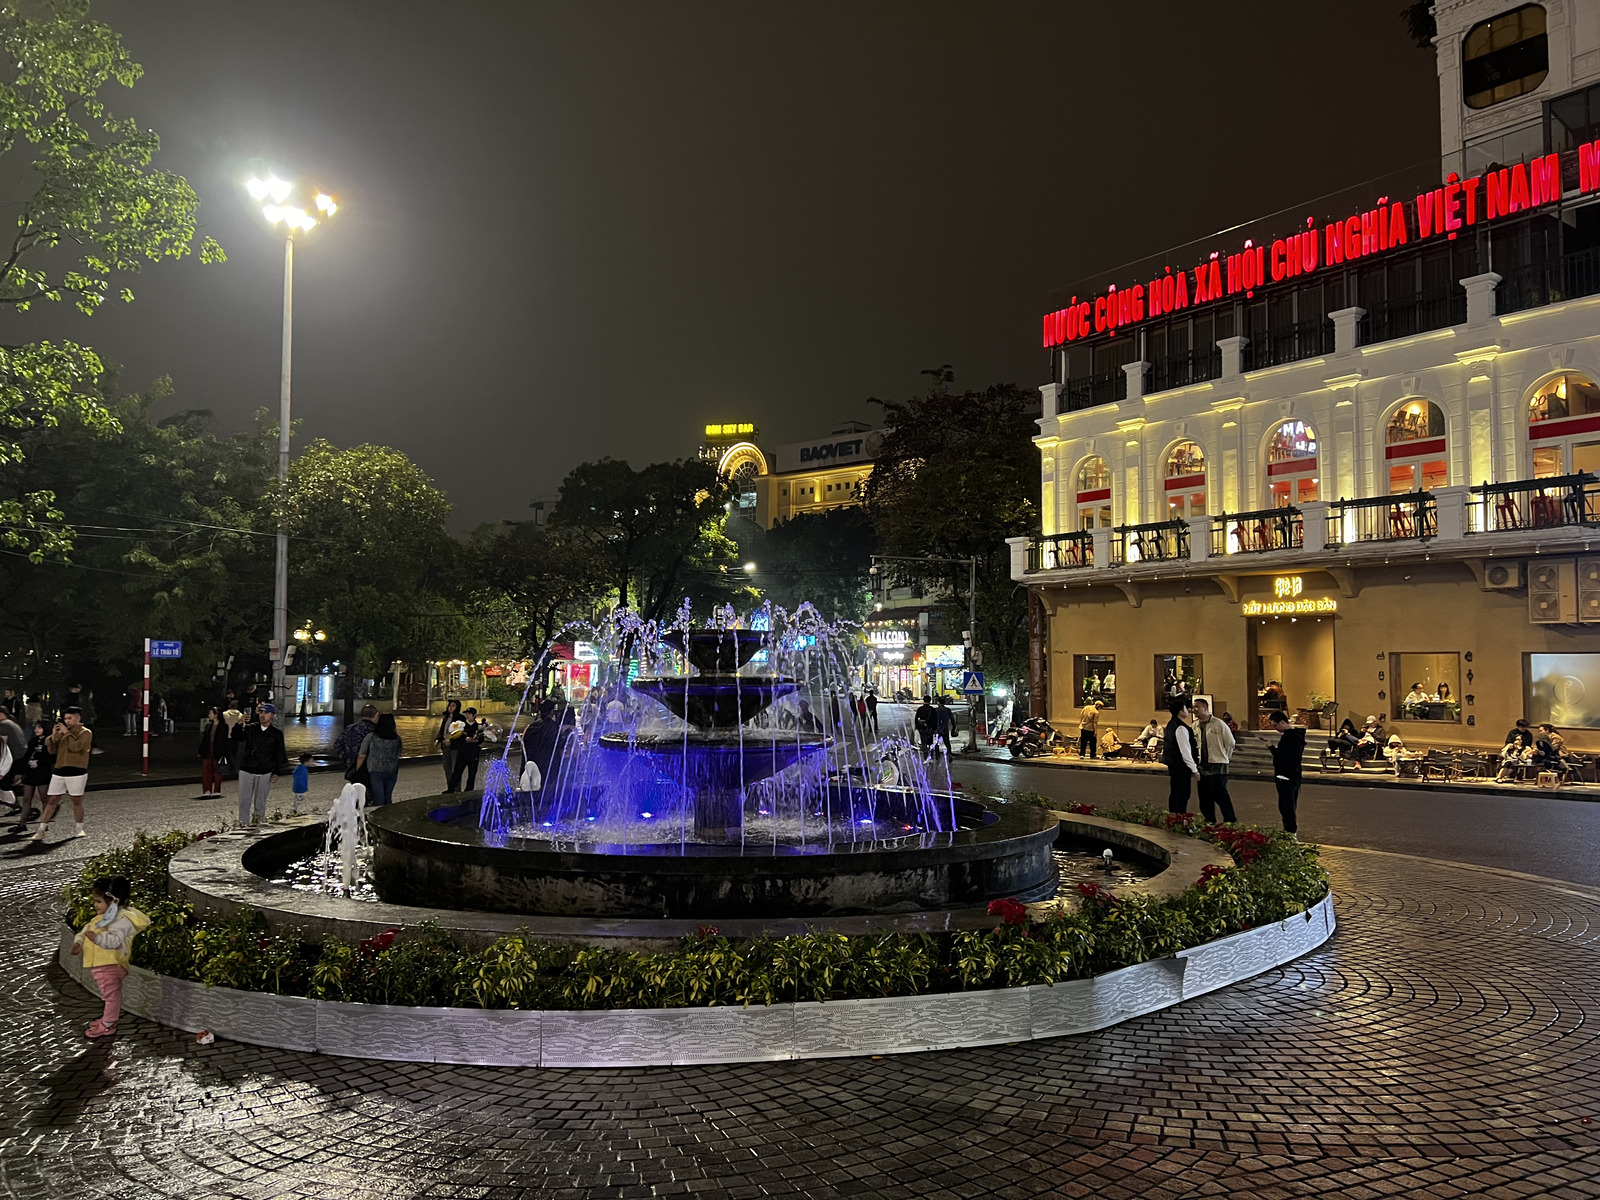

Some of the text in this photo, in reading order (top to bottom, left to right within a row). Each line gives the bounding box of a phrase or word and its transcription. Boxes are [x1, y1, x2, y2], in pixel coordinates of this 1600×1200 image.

[1043, 296, 1090, 348] NƯỚC
[1095, 284, 1144, 337] CỘNG
[1149, 266, 1188, 317] HÒA
[1194, 251, 1222, 305] XÃ
[1227, 239, 1264, 298] HỘI
[1271, 216, 1318, 281] CHỦ
[1325, 196, 1407, 266] NGHĨA
[1416, 172, 1479, 240] VIỆT
[1487, 153, 1560, 220] NAM
